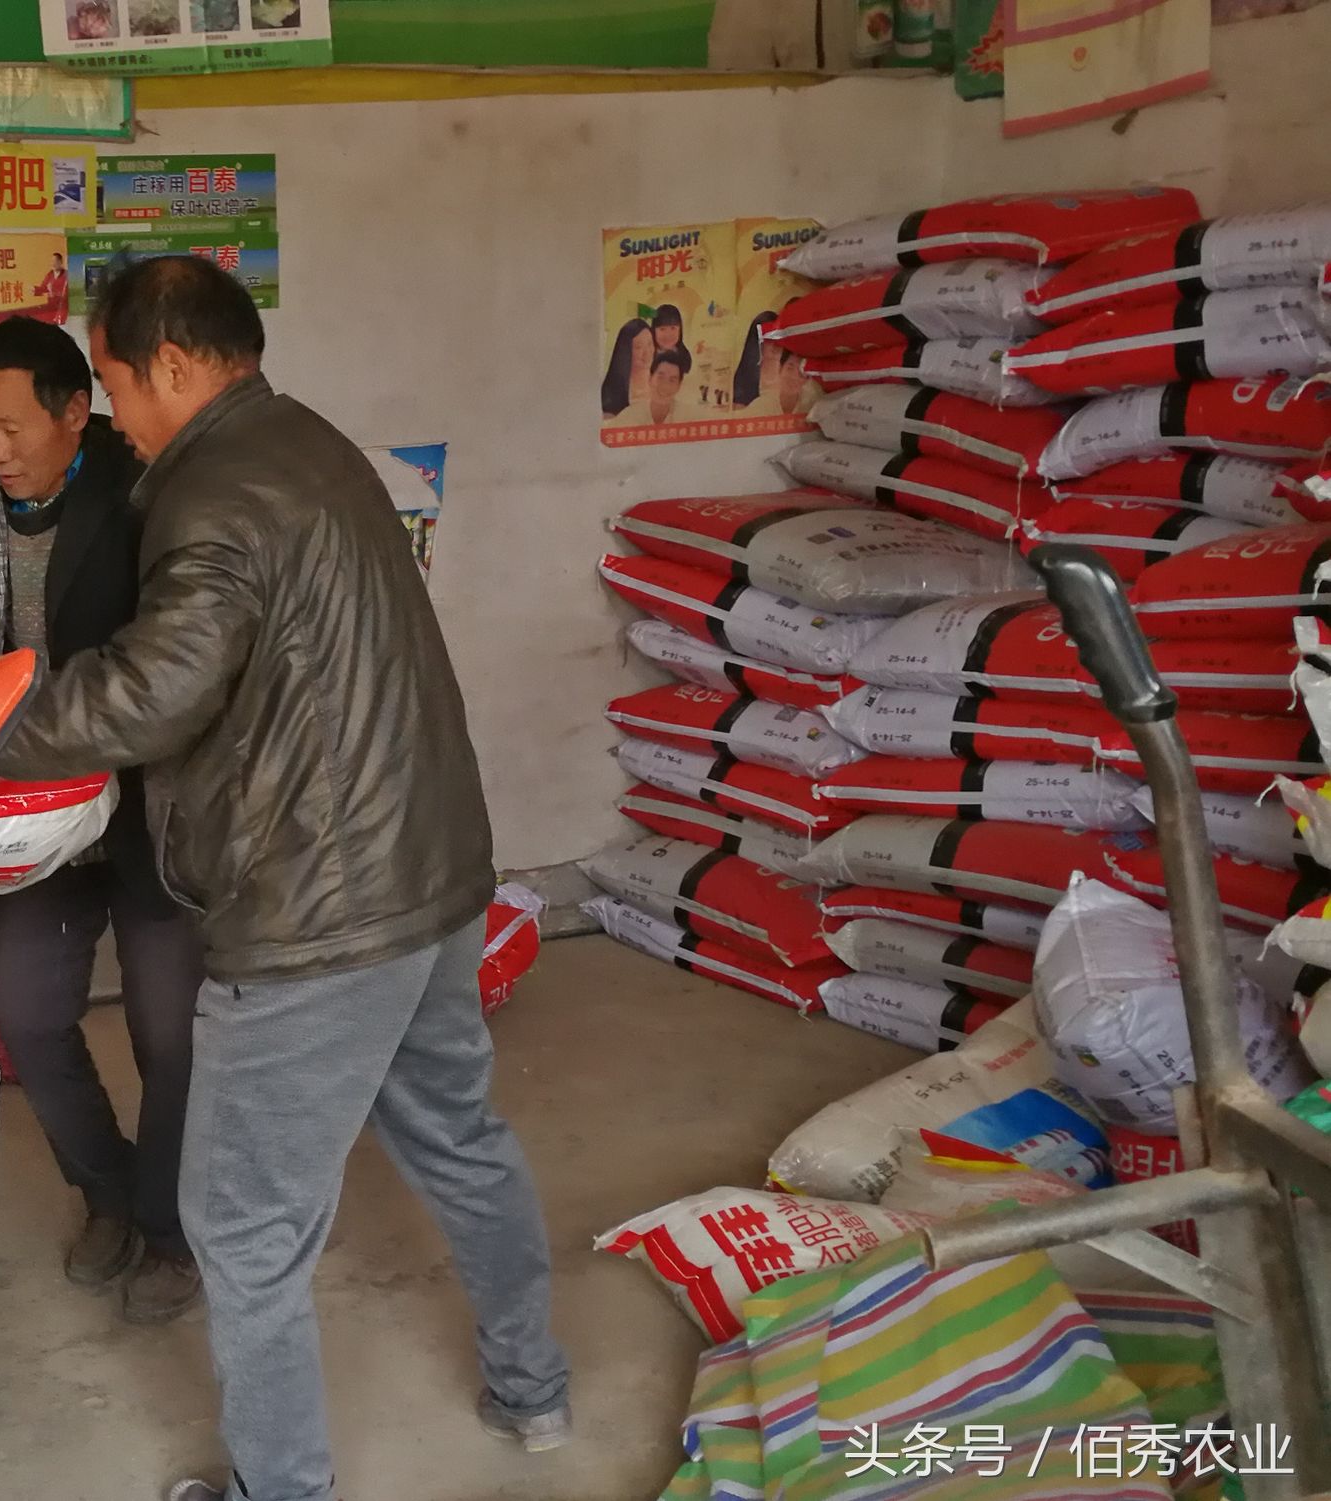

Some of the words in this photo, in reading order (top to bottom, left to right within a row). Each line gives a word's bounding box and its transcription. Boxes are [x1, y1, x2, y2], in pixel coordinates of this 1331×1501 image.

[170, 198, 259, 218] 保叶促增产
[620, 231, 701, 257] SUNLIGHT
[636, 249, 694, 282] 阳光
[888, 654, 929, 665] 25-14-6
[875, 705, 917, 717] 25-14-6
[1025, 776, 1071, 788] 25-14-6
[1026, 809, 1074, 819] 25-14-6
